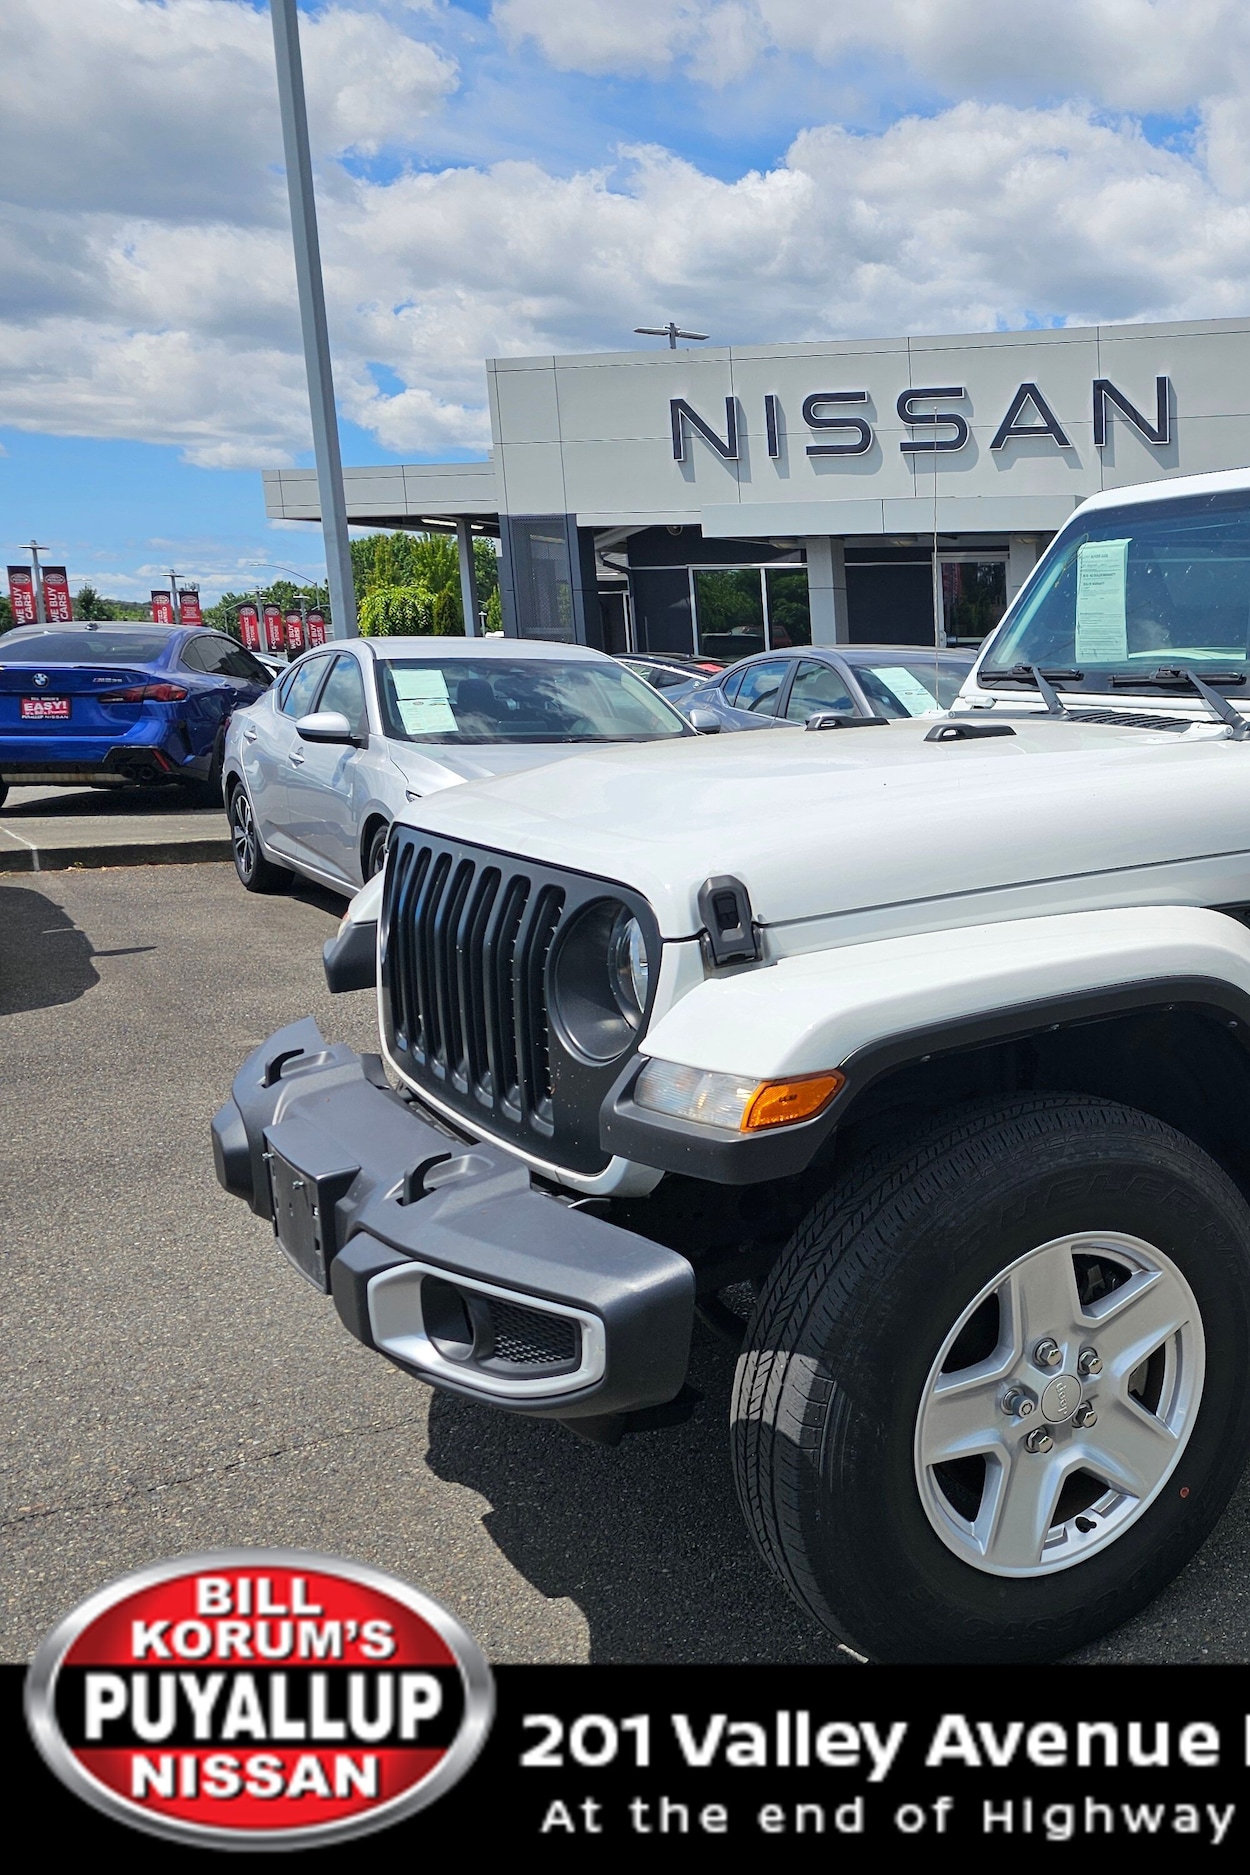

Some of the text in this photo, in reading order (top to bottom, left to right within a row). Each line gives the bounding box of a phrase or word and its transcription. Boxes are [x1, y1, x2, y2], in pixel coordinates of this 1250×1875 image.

[670, 376, 1170, 462] NISSAN
[13, 587, 23, 607] BUY
[23, 592, 33, 619] CARS!
[48, 587, 58, 607] BUY
[58, 592, 68, 620] CARS!
[17, 609, 27, 624] WE
[24, 701, 68, 711] EASY!
